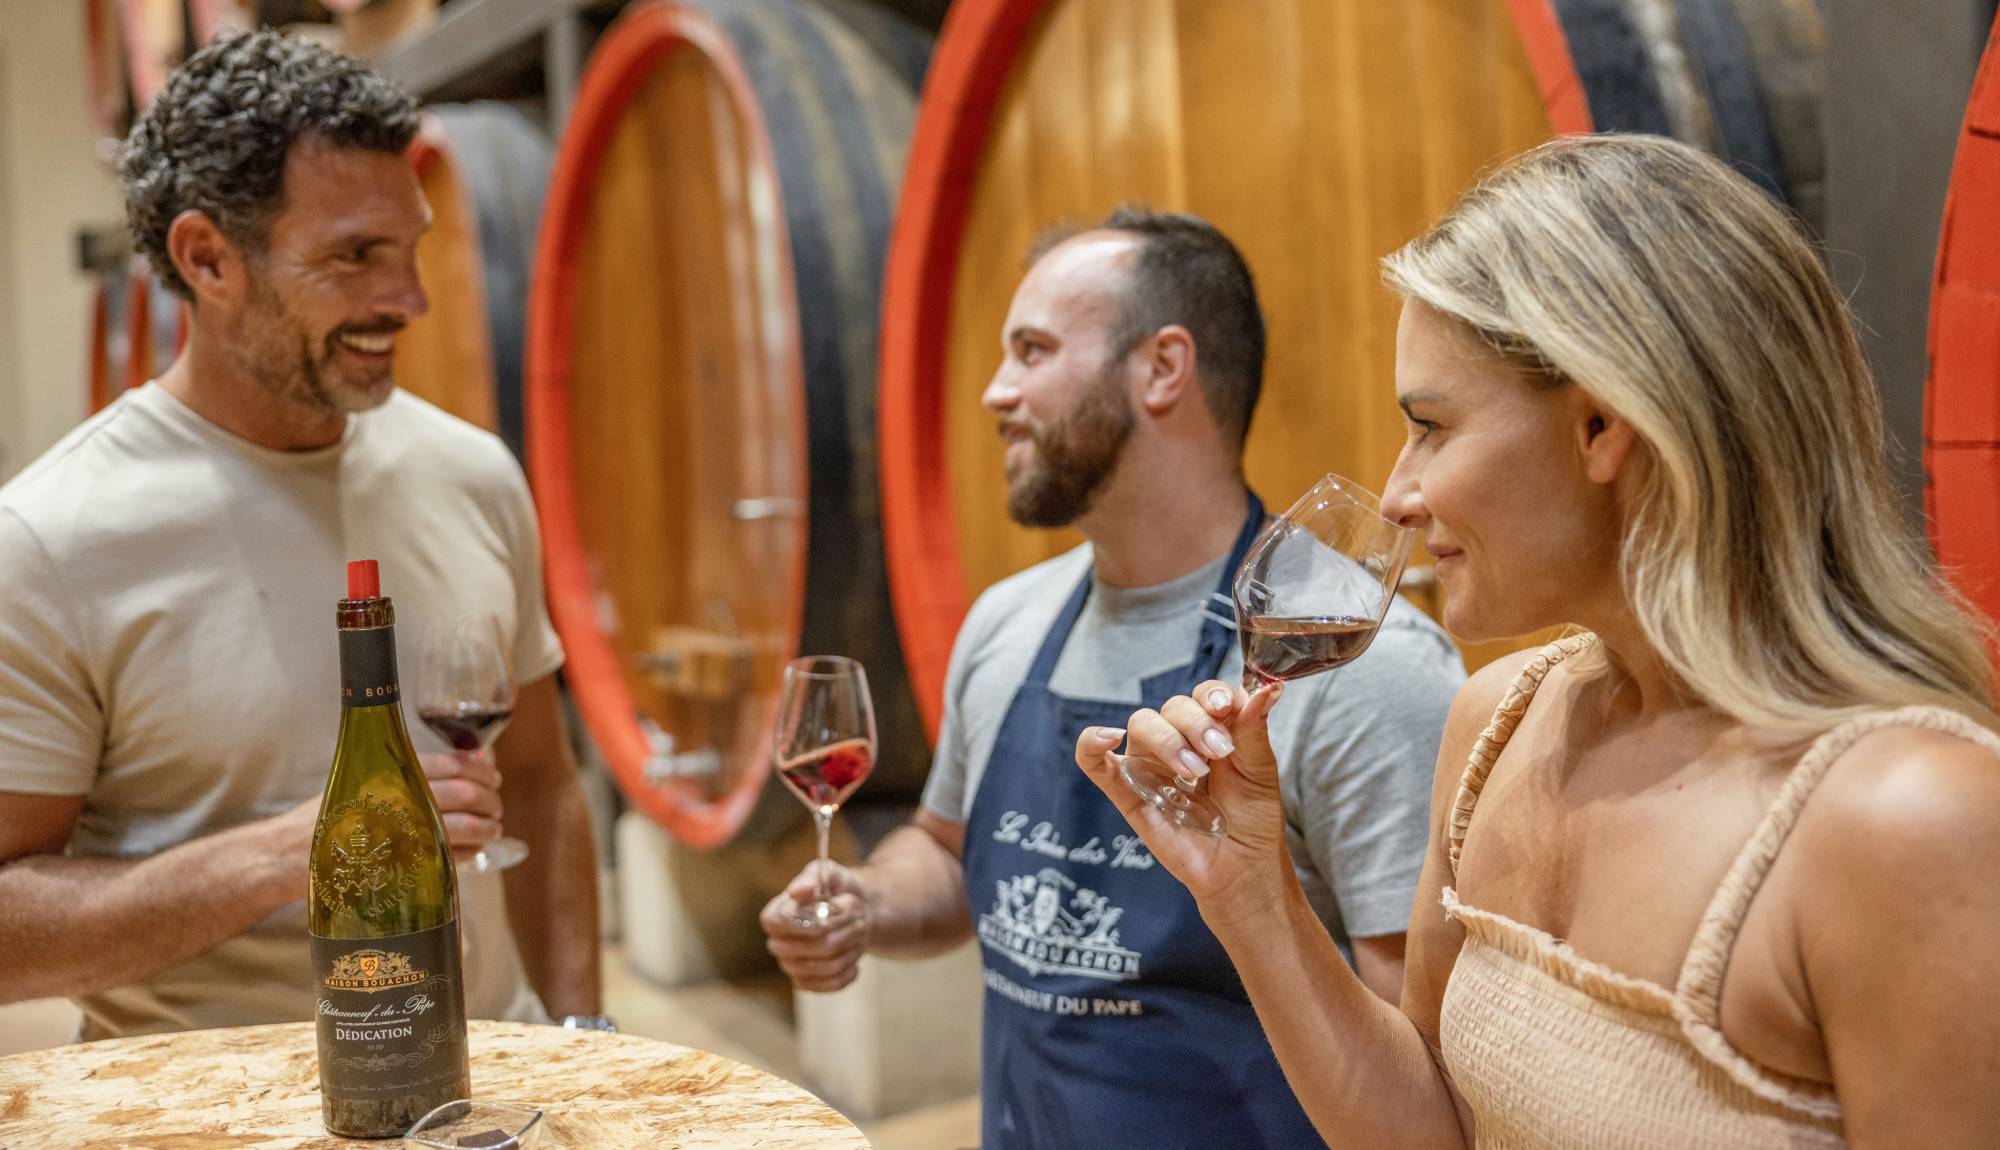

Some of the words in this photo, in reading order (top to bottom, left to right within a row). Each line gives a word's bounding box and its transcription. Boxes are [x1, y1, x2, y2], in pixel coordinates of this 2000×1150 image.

[1025, 939, 1140, 974] BOUACHON
[364, 959, 375, 971] B
[325, 978, 358, 987] MAISON
[363, 972, 425, 987] BOUACHON
[1056, 995, 1089, 1015] DU
[1093, 998, 1143, 1015] PAPE
[336, 1026, 412, 1041] DÉDICATION
